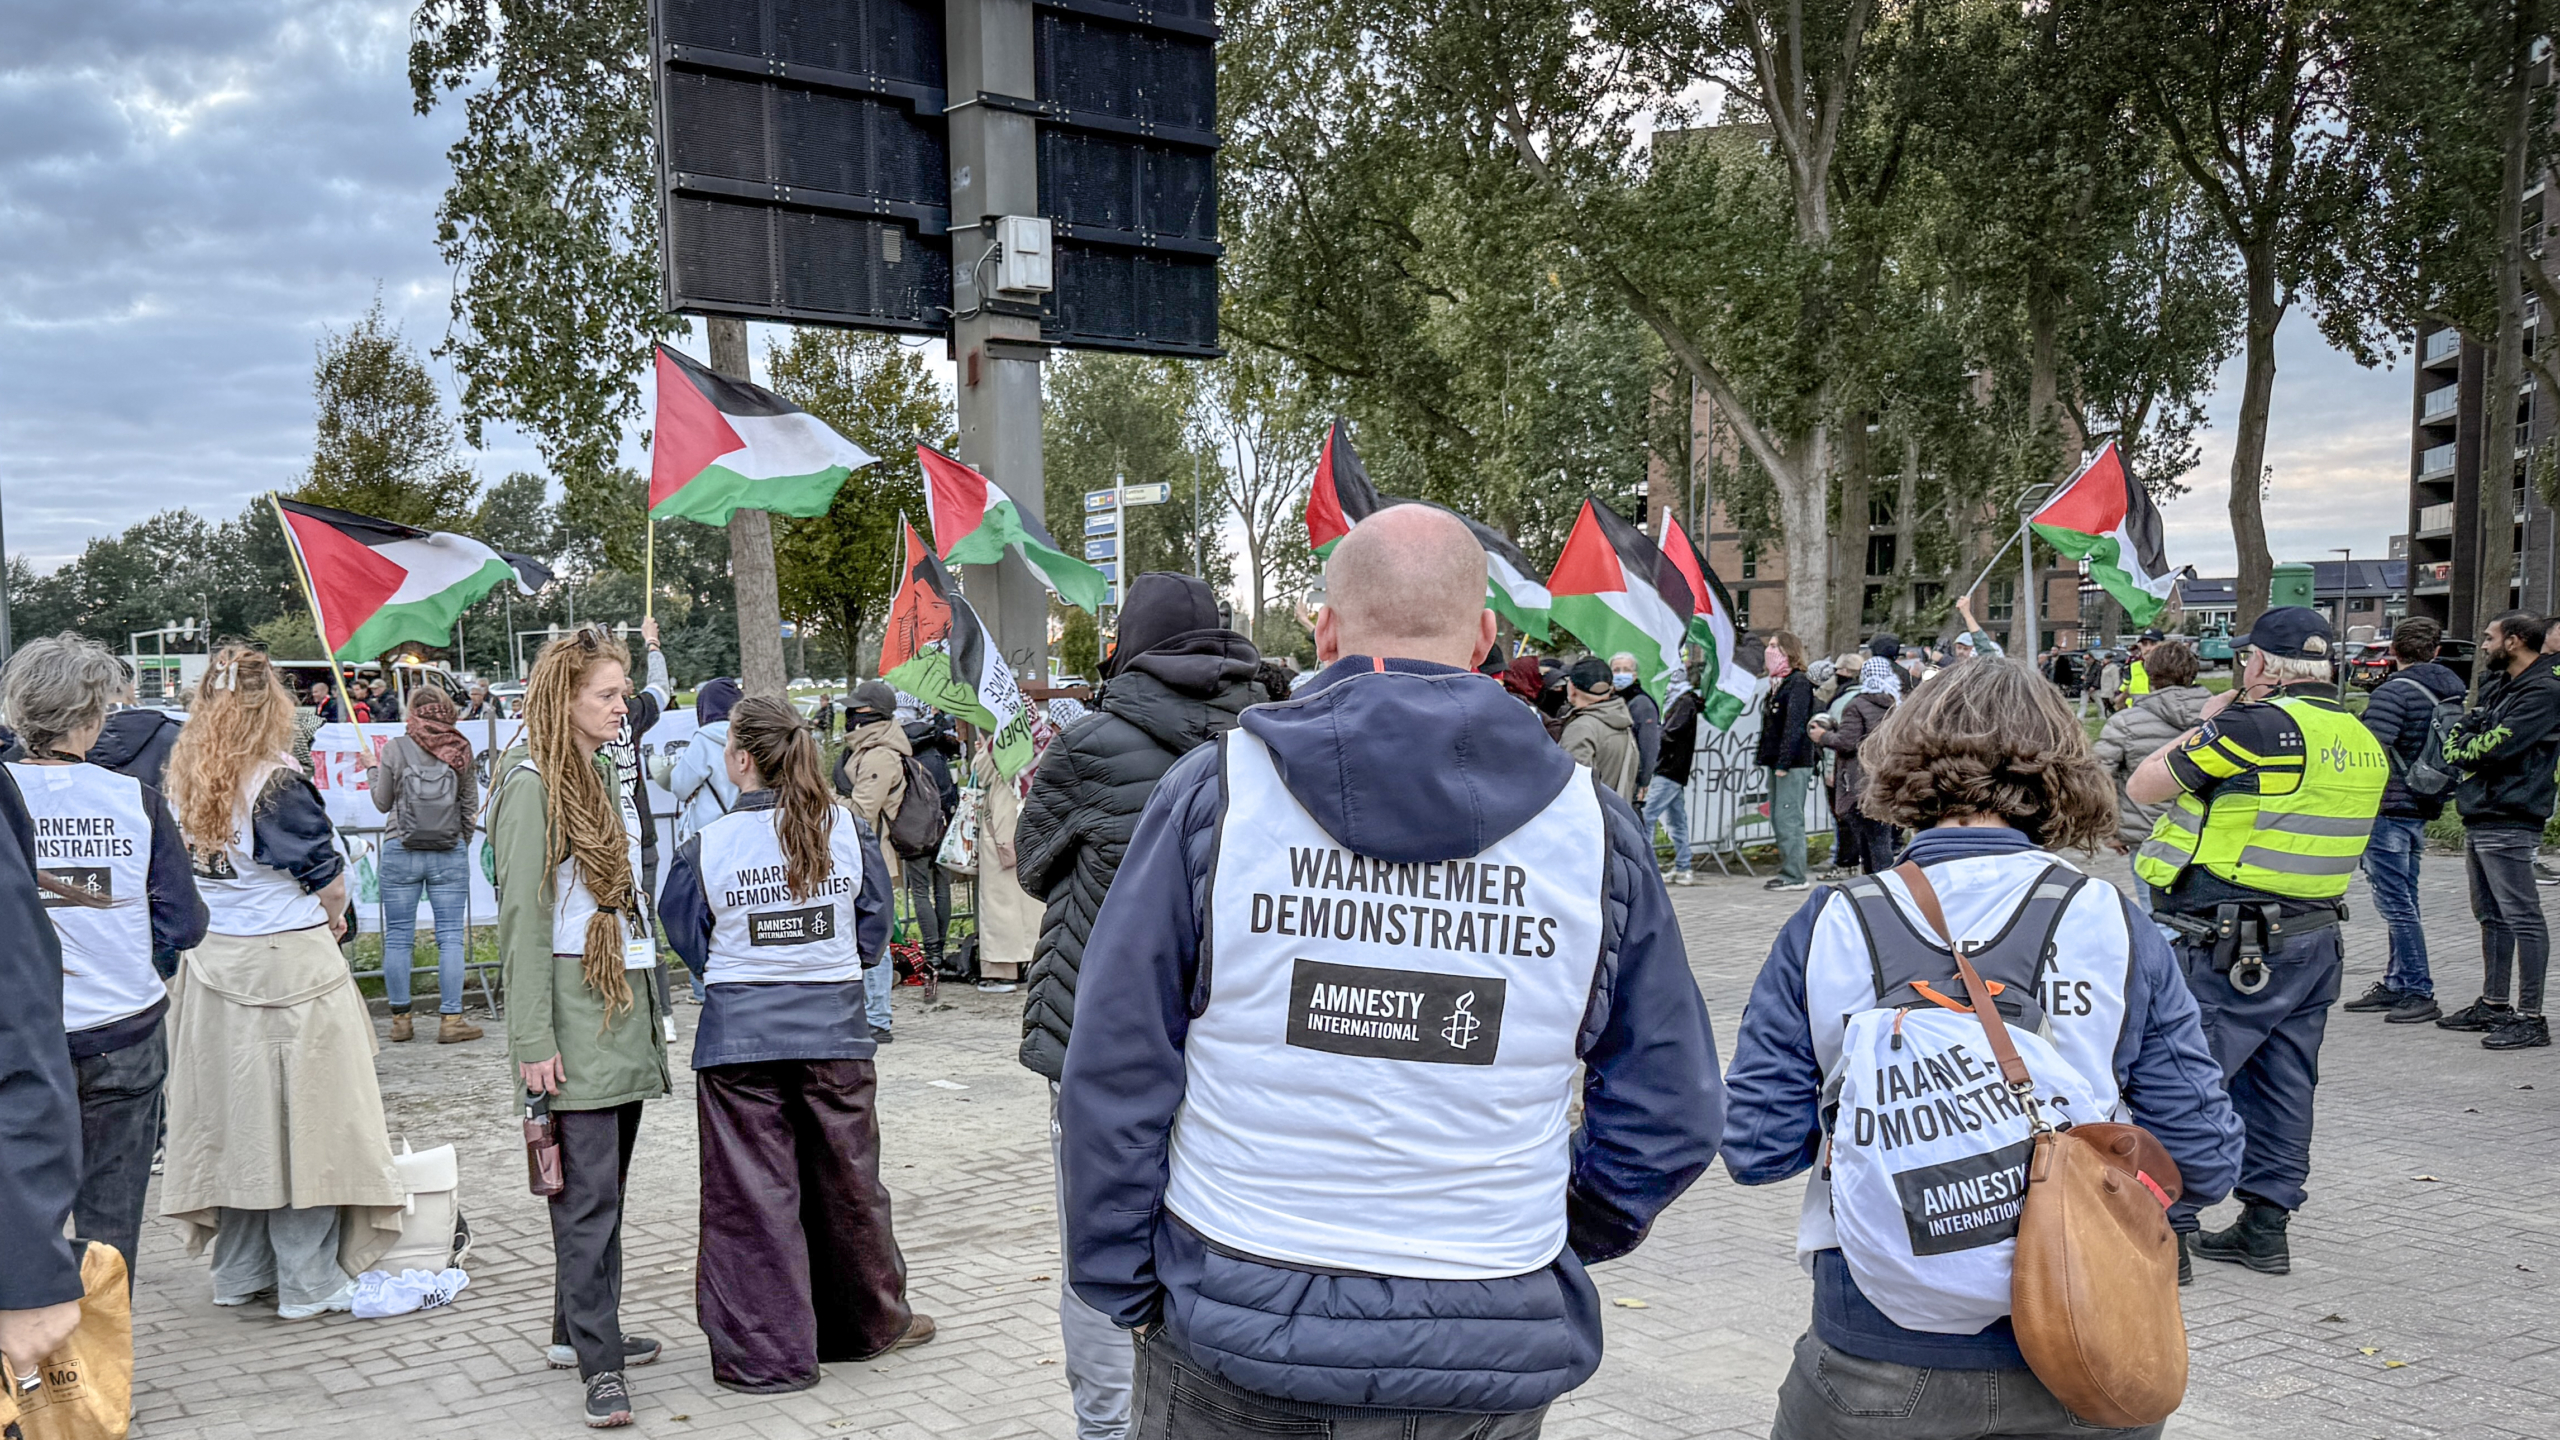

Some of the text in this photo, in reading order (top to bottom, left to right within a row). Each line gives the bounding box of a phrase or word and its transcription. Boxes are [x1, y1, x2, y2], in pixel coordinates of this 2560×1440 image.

[37, 839, 133, 858] NSTRATIES
[1290, 847, 1526, 907] WAARNEMER
[757, 917, 804, 932] AMNESTY
[757, 930, 805, 940] INTERNATIONAL
[1251, 893, 1557, 958] DEMONSTRATIES
[1310, 983, 1426, 1019] AMNESTY
[1307, 1013, 1420, 1042] INTERNATIONAL
[1923, 1163, 2026, 1217] AMNESTY
[1928, 1195, 2025, 1237] INTERNATION
[49, 1370, 77, 1386] Mo
